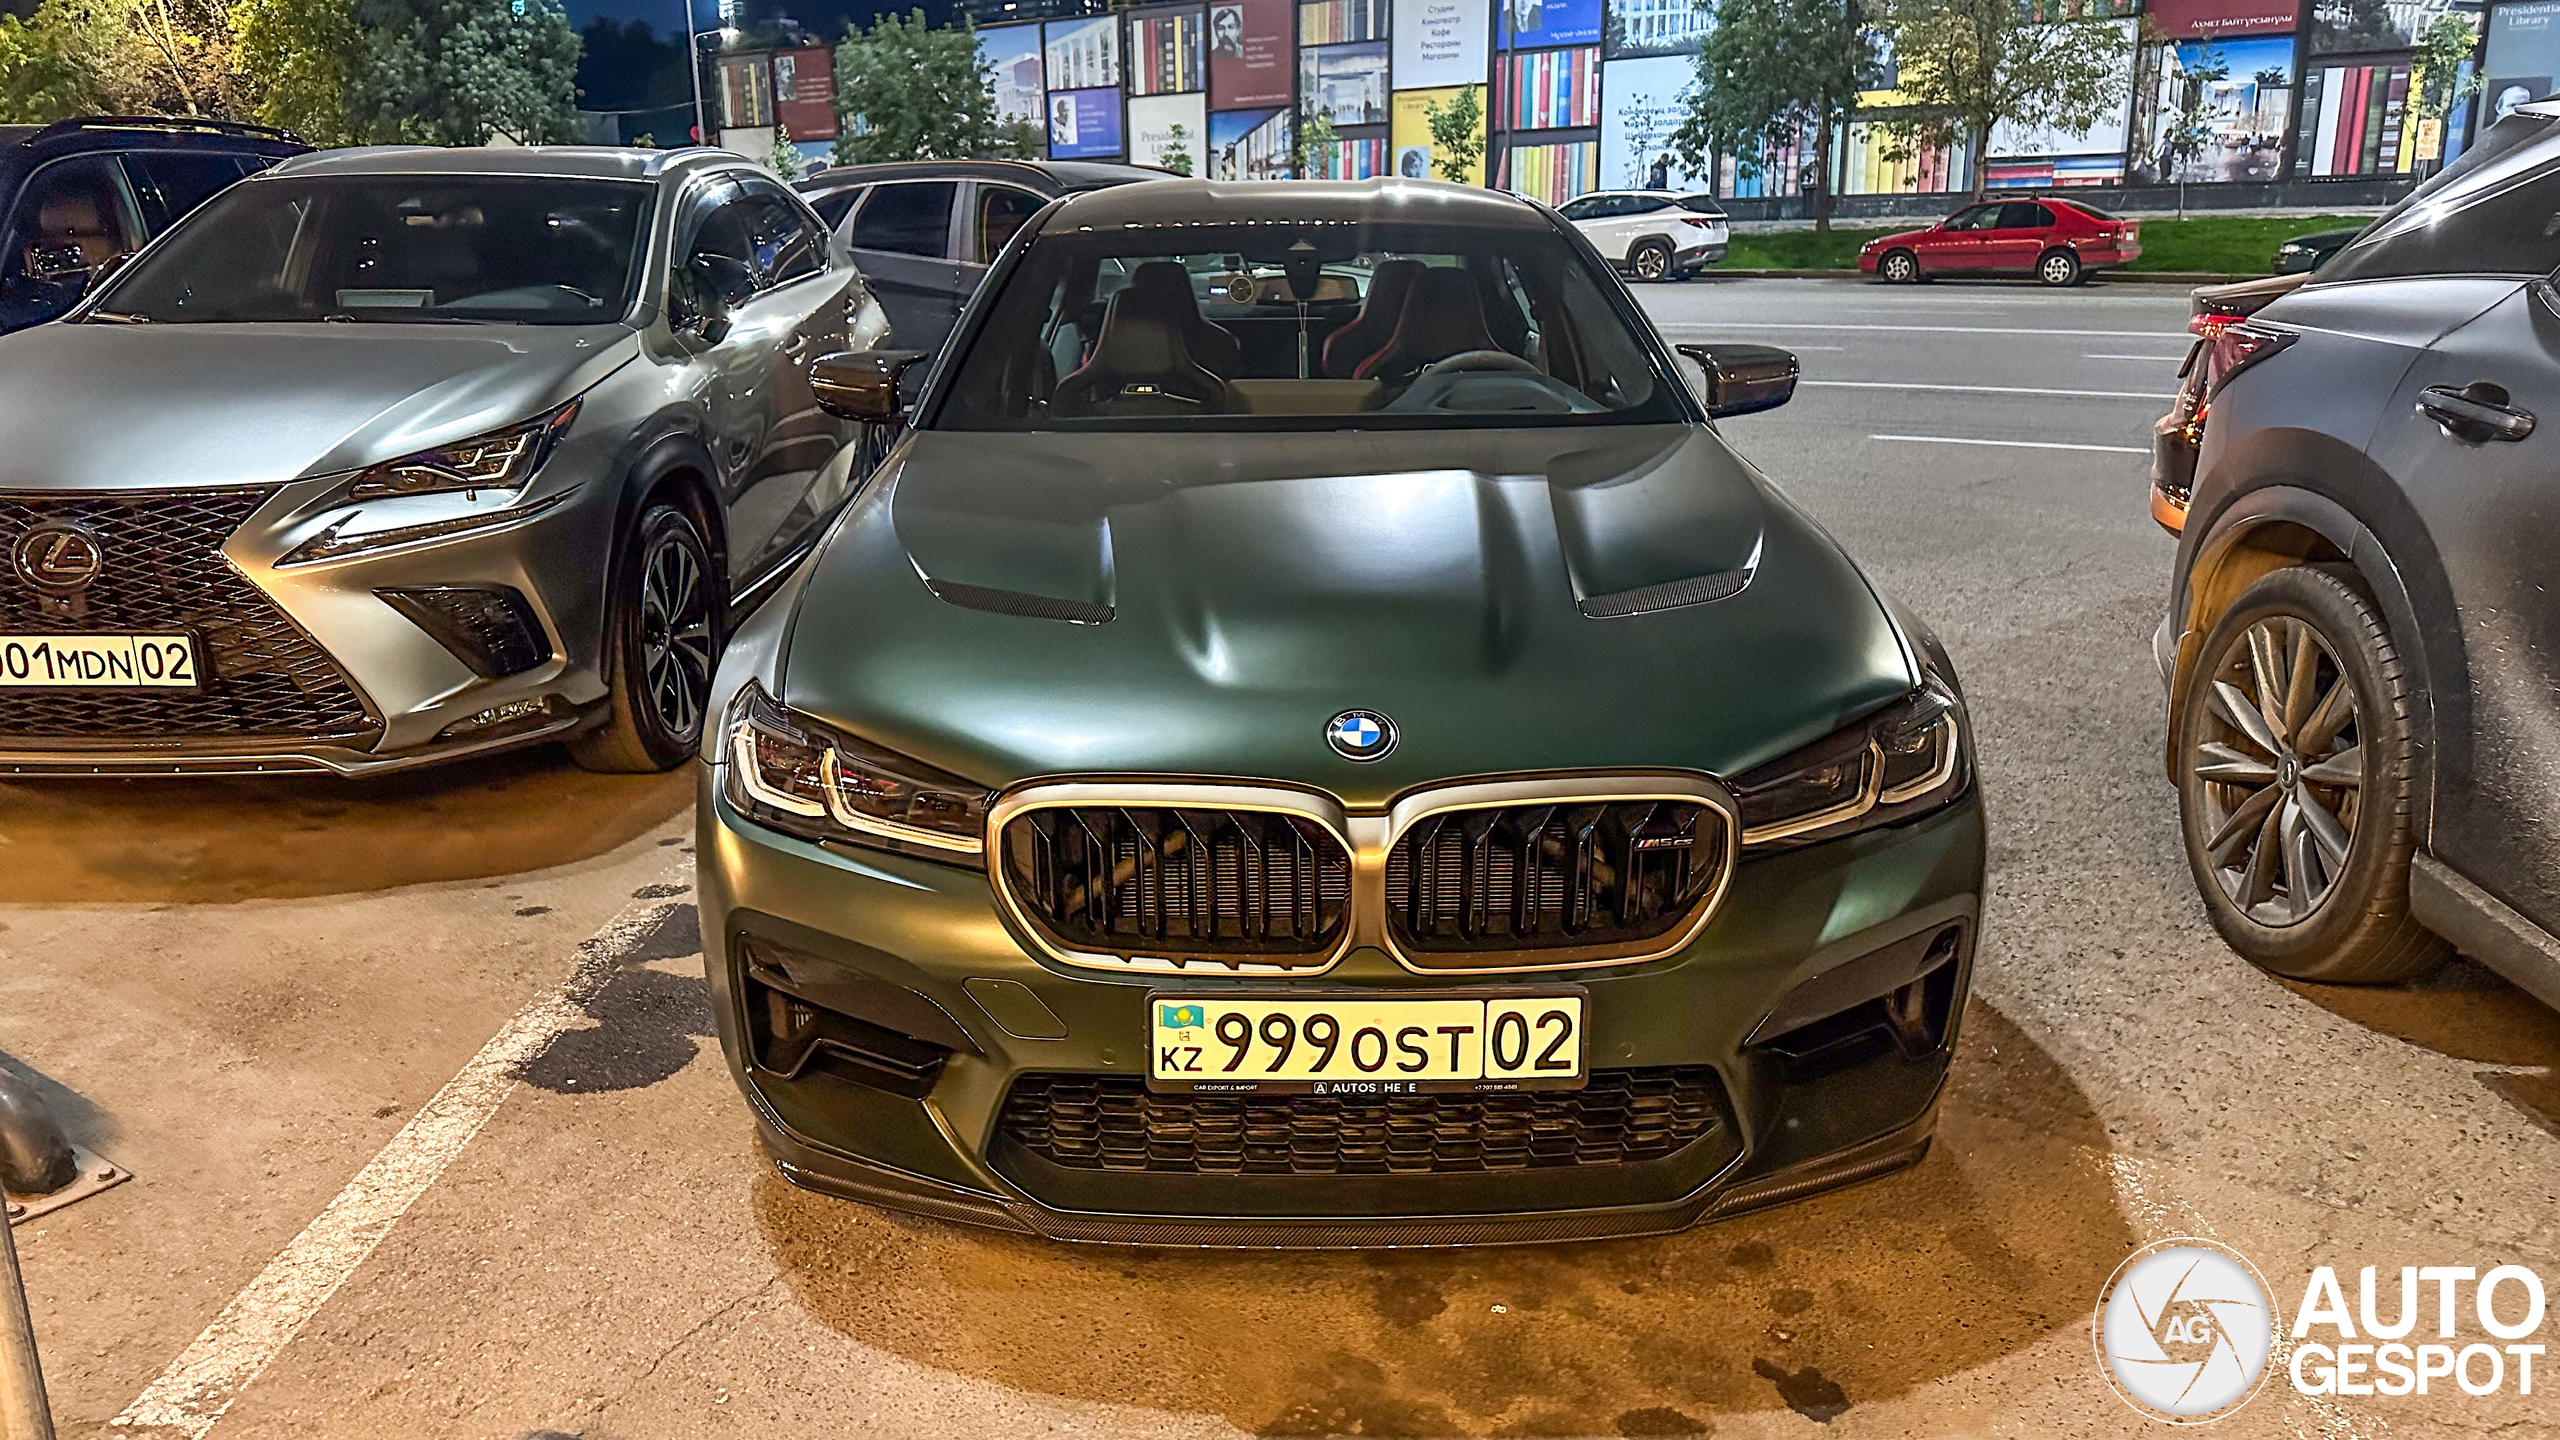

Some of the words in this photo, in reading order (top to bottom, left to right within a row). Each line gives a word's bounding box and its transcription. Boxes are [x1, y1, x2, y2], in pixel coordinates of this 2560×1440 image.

[2498, 4, 2560, 17] Presidentia
[1421, 16, 1461, 25] Кинотеатр
[2508, 16, 2550, 26] Library
[0, 642, 133, 680] 01MDN
[141, 642, 192, 680] 02
[1333, 712, 1386, 727] BMW
[1491, 1010, 1573, 1071] 02
[1161, 1046, 1203, 1072] KZ
[1331, 1082, 1377, 1093] AUTOS
